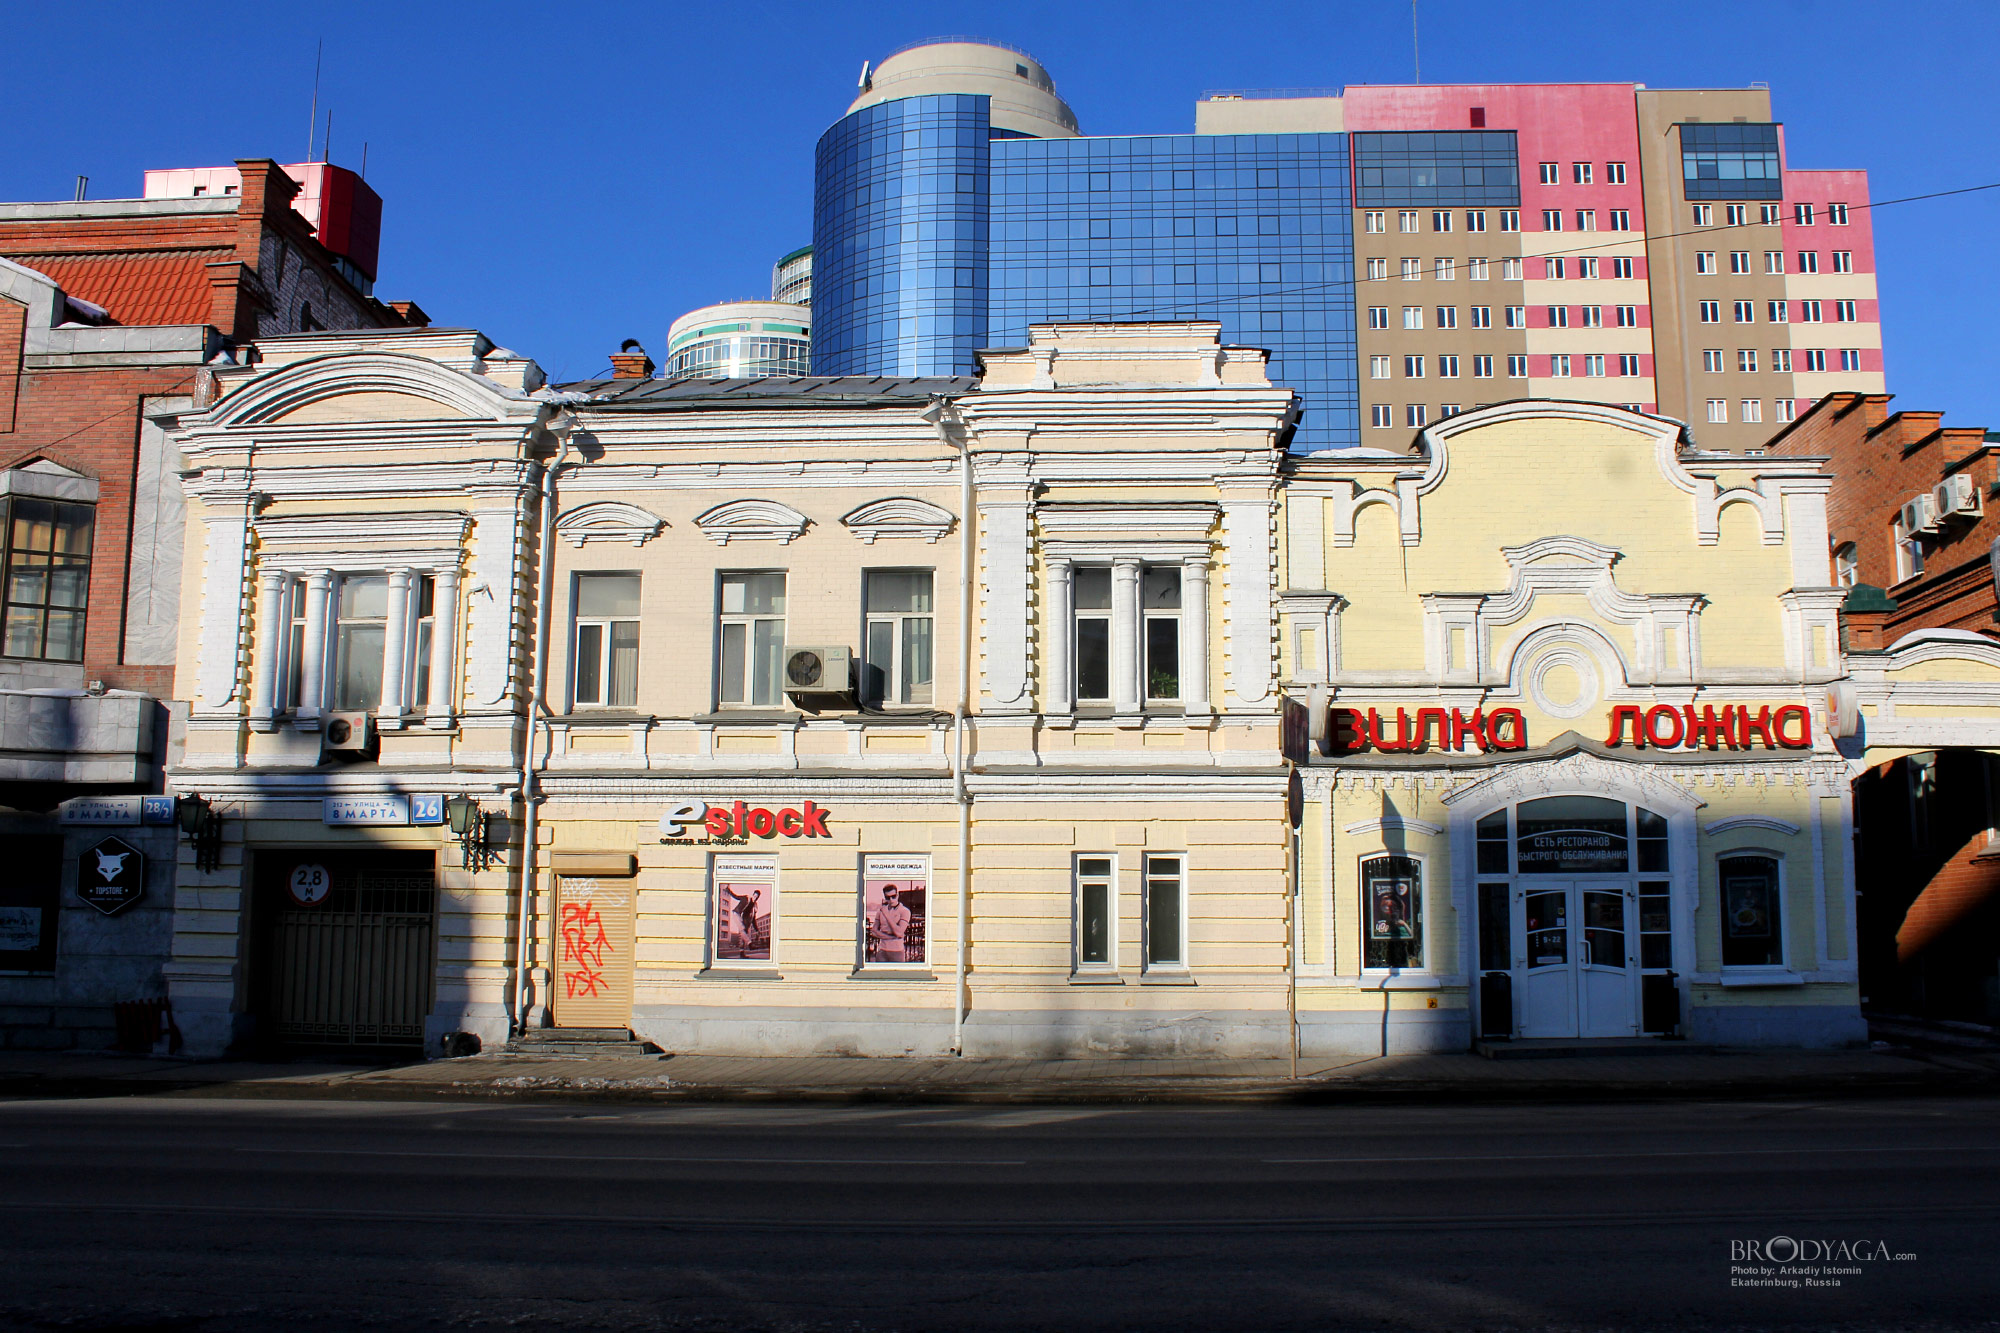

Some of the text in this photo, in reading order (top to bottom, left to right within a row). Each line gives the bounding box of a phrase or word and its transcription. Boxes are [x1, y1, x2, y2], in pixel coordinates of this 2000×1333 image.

[68, 810, 130, 819] 8 МАРТА
[146, 802, 171, 819] 28/2
[333, 809, 397, 819] 8 МАРТА
[415, 801, 438, 818] 26
[1534, 836, 1610, 847] СЕТЬ РЕСТОРАНОВ
[1518, 850, 1628, 861] БЫСТРОГО ОБСЛУЖИВАНИЯ
[297, 870, 322, 887] 2,8
[95, 886, 124, 895] TOPSTORE
